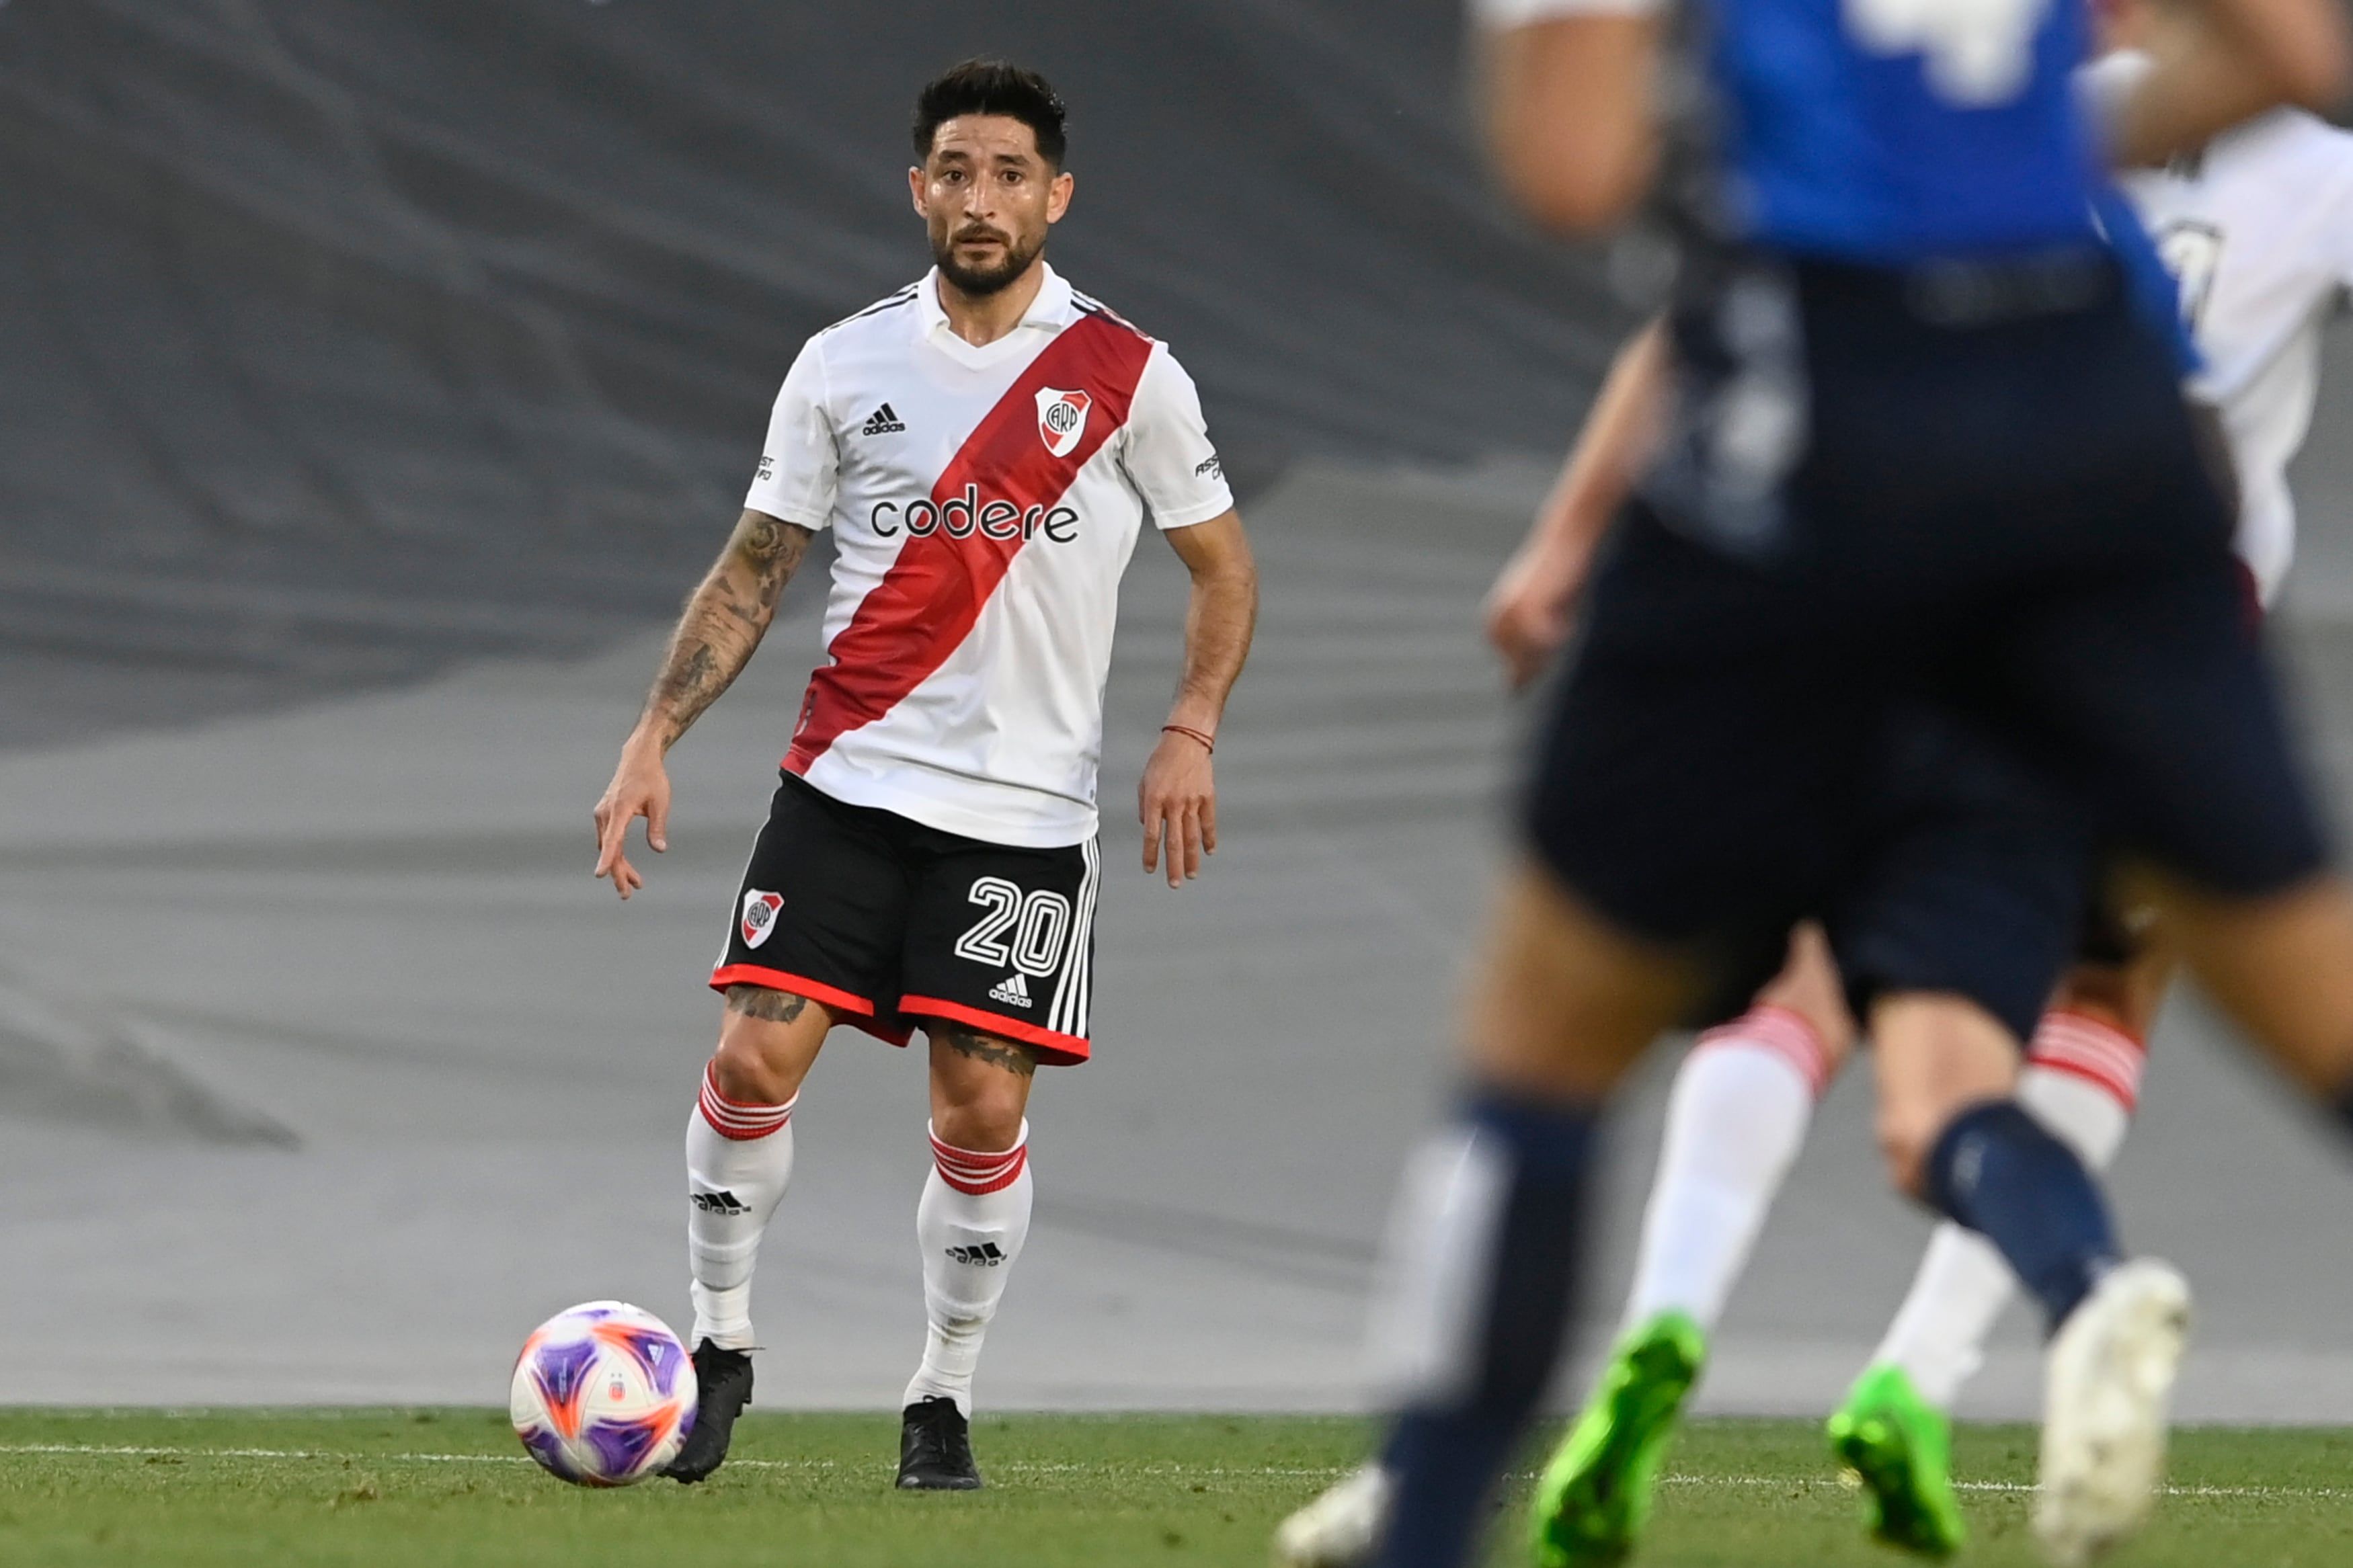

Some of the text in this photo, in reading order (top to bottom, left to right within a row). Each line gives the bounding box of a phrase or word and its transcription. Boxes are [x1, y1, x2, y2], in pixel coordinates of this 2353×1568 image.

[863, 421, 906, 436] adidas
[871, 485, 1079, 543] codere
[954, 876, 1070, 978] 20
[988, 988, 1033, 1009] adidas
